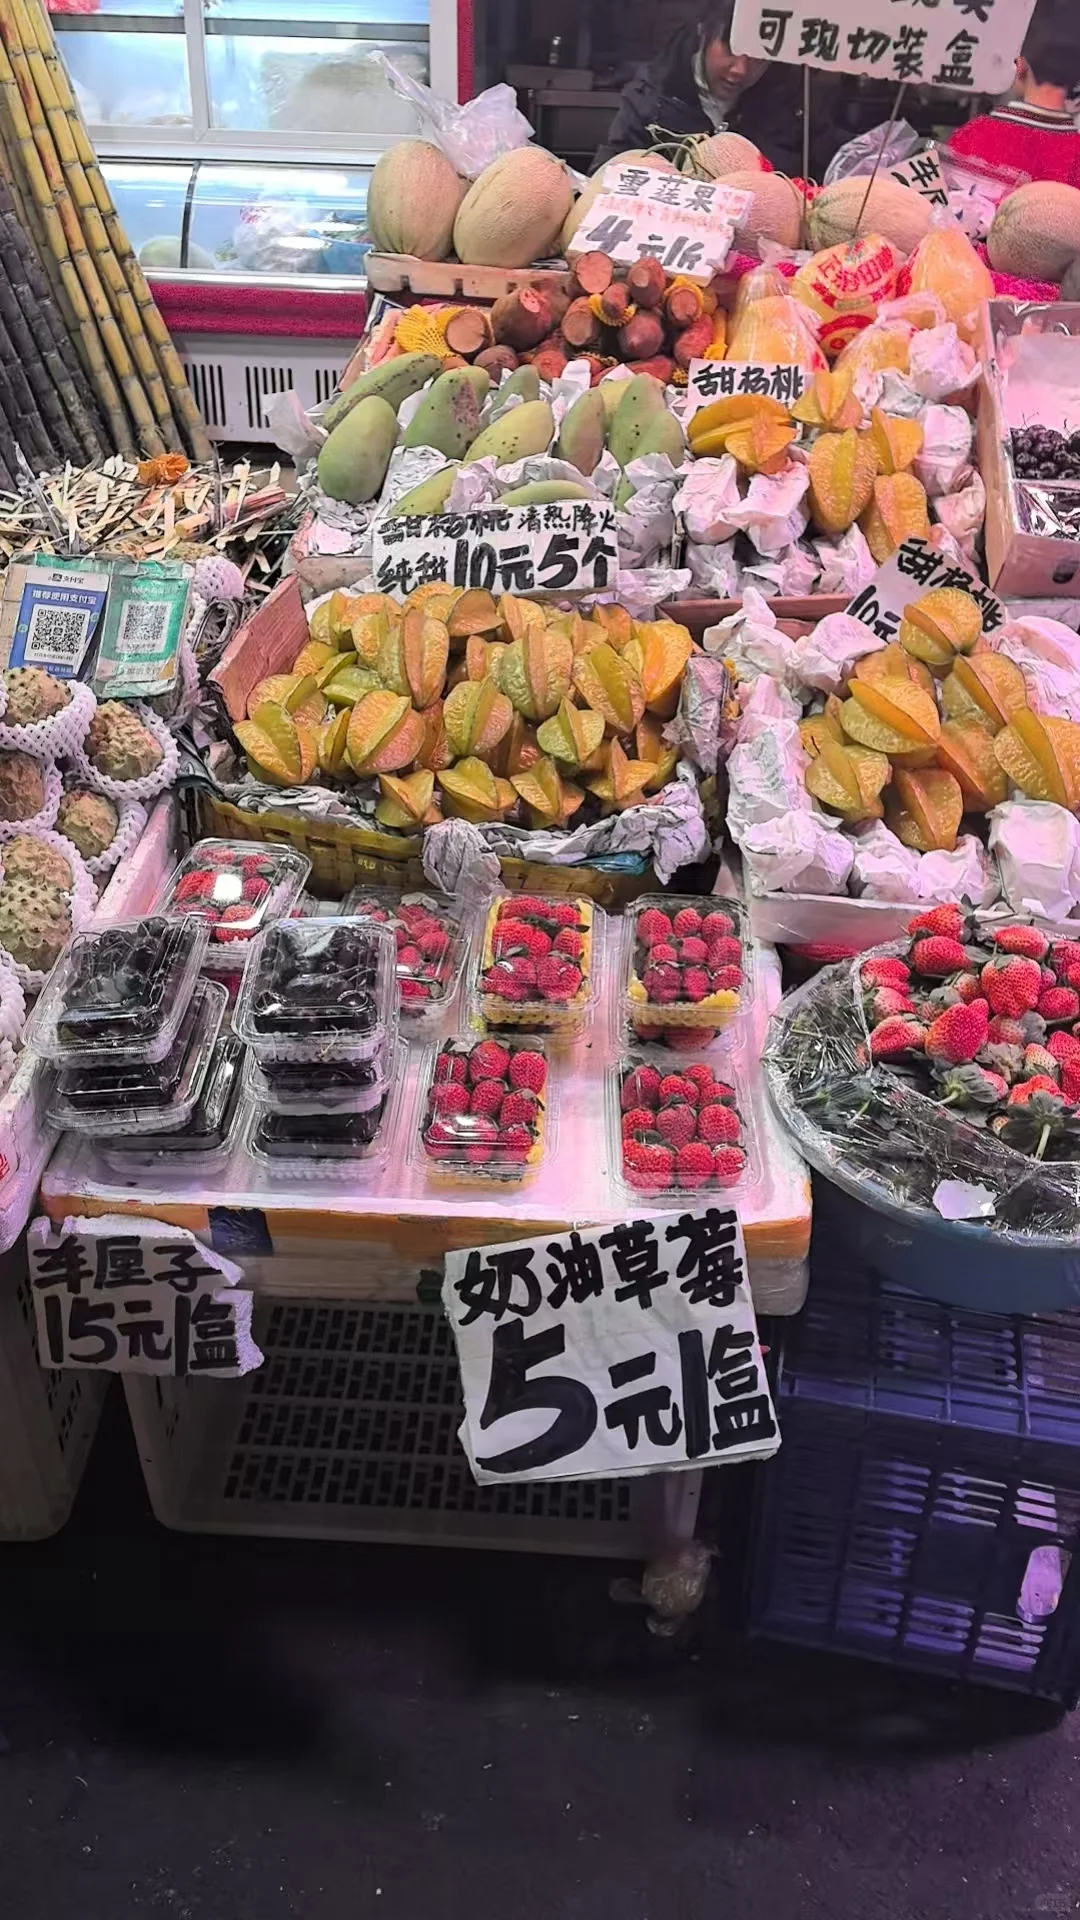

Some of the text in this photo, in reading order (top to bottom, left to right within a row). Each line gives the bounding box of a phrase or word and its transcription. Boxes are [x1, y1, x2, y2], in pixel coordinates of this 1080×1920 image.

[759, 8, 980, 86] 可现切装盒
[692, 363, 804, 400] 甜杨桃
[452, 533, 617, 591] 10元5个
[32, 589, 97, 605] 推荐使用支付宝
[33, 1234, 223, 1295] 车厘子
[453, 1207, 744, 1326] 奶油草莓
[44, 1293, 240, 1377] 15元1盒
[475, 1316, 777, 1475] 5元1盒
